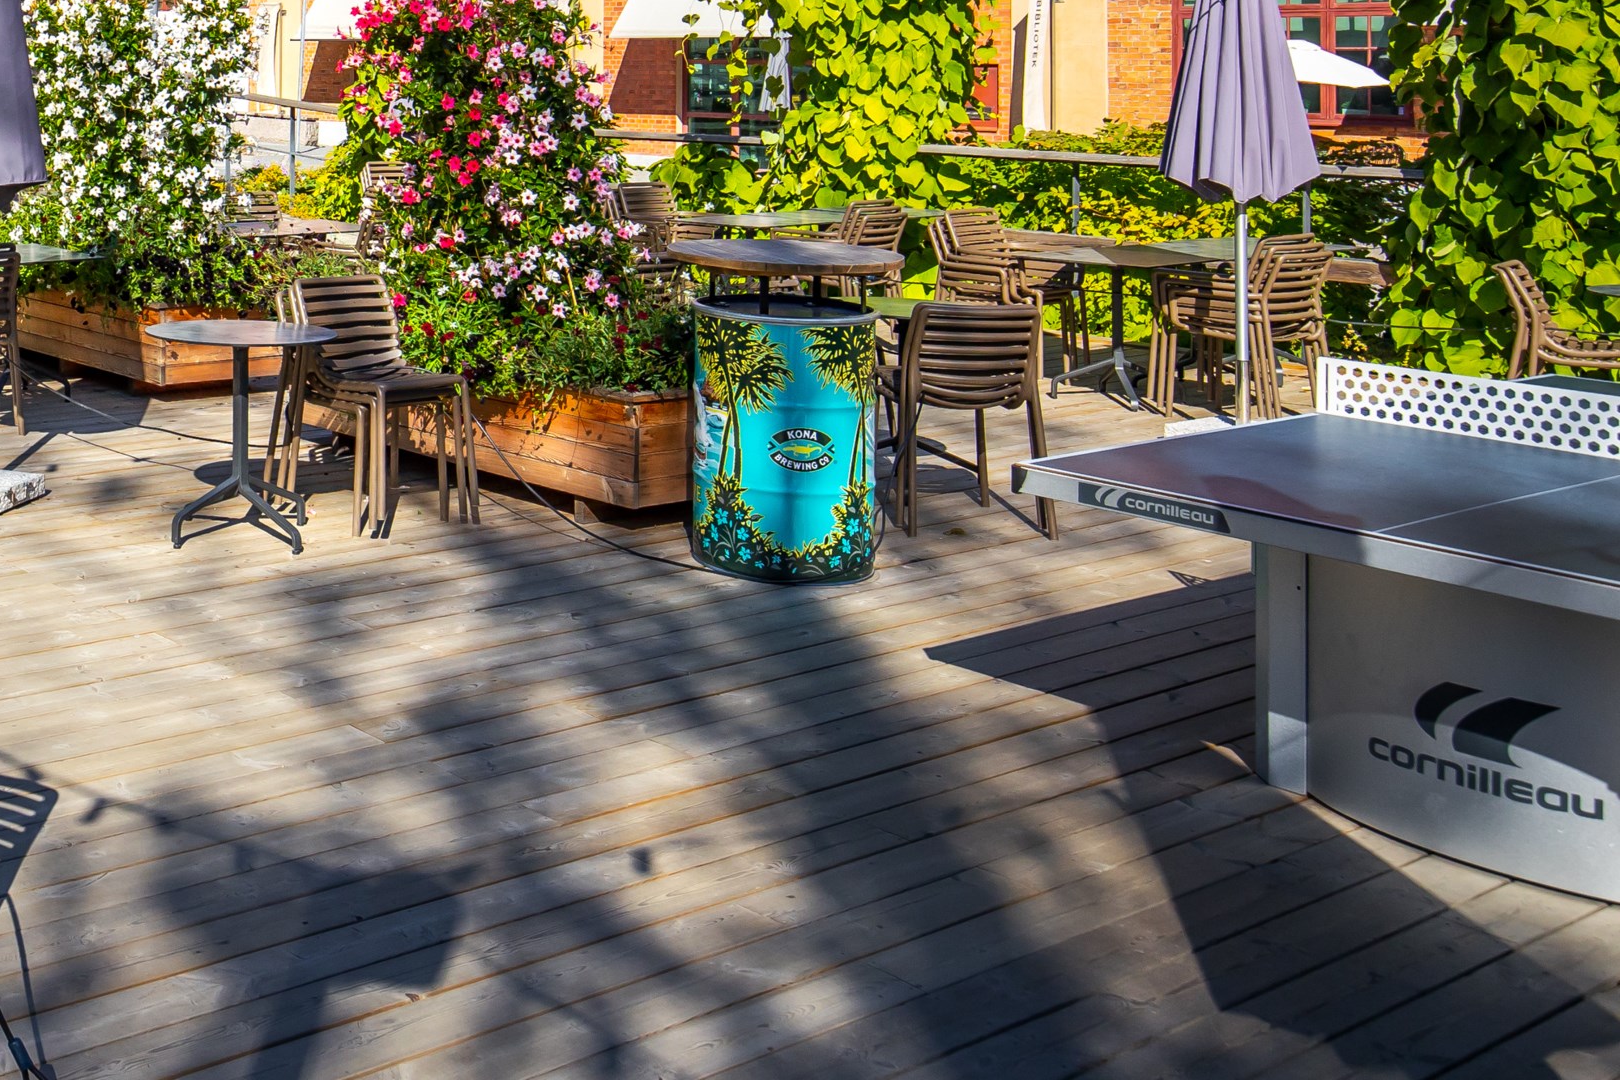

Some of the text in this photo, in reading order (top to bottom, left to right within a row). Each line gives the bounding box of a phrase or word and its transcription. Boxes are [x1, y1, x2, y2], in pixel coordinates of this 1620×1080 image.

[1032, 0, 1042, 67] BIBLIOTEK
[787, 430, 817, 440] KONA
[774, 453, 818, 470] BREWING
[1125, 497, 1214, 525] cornilleau
[1368, 737, 1603, 820] cornilleau
